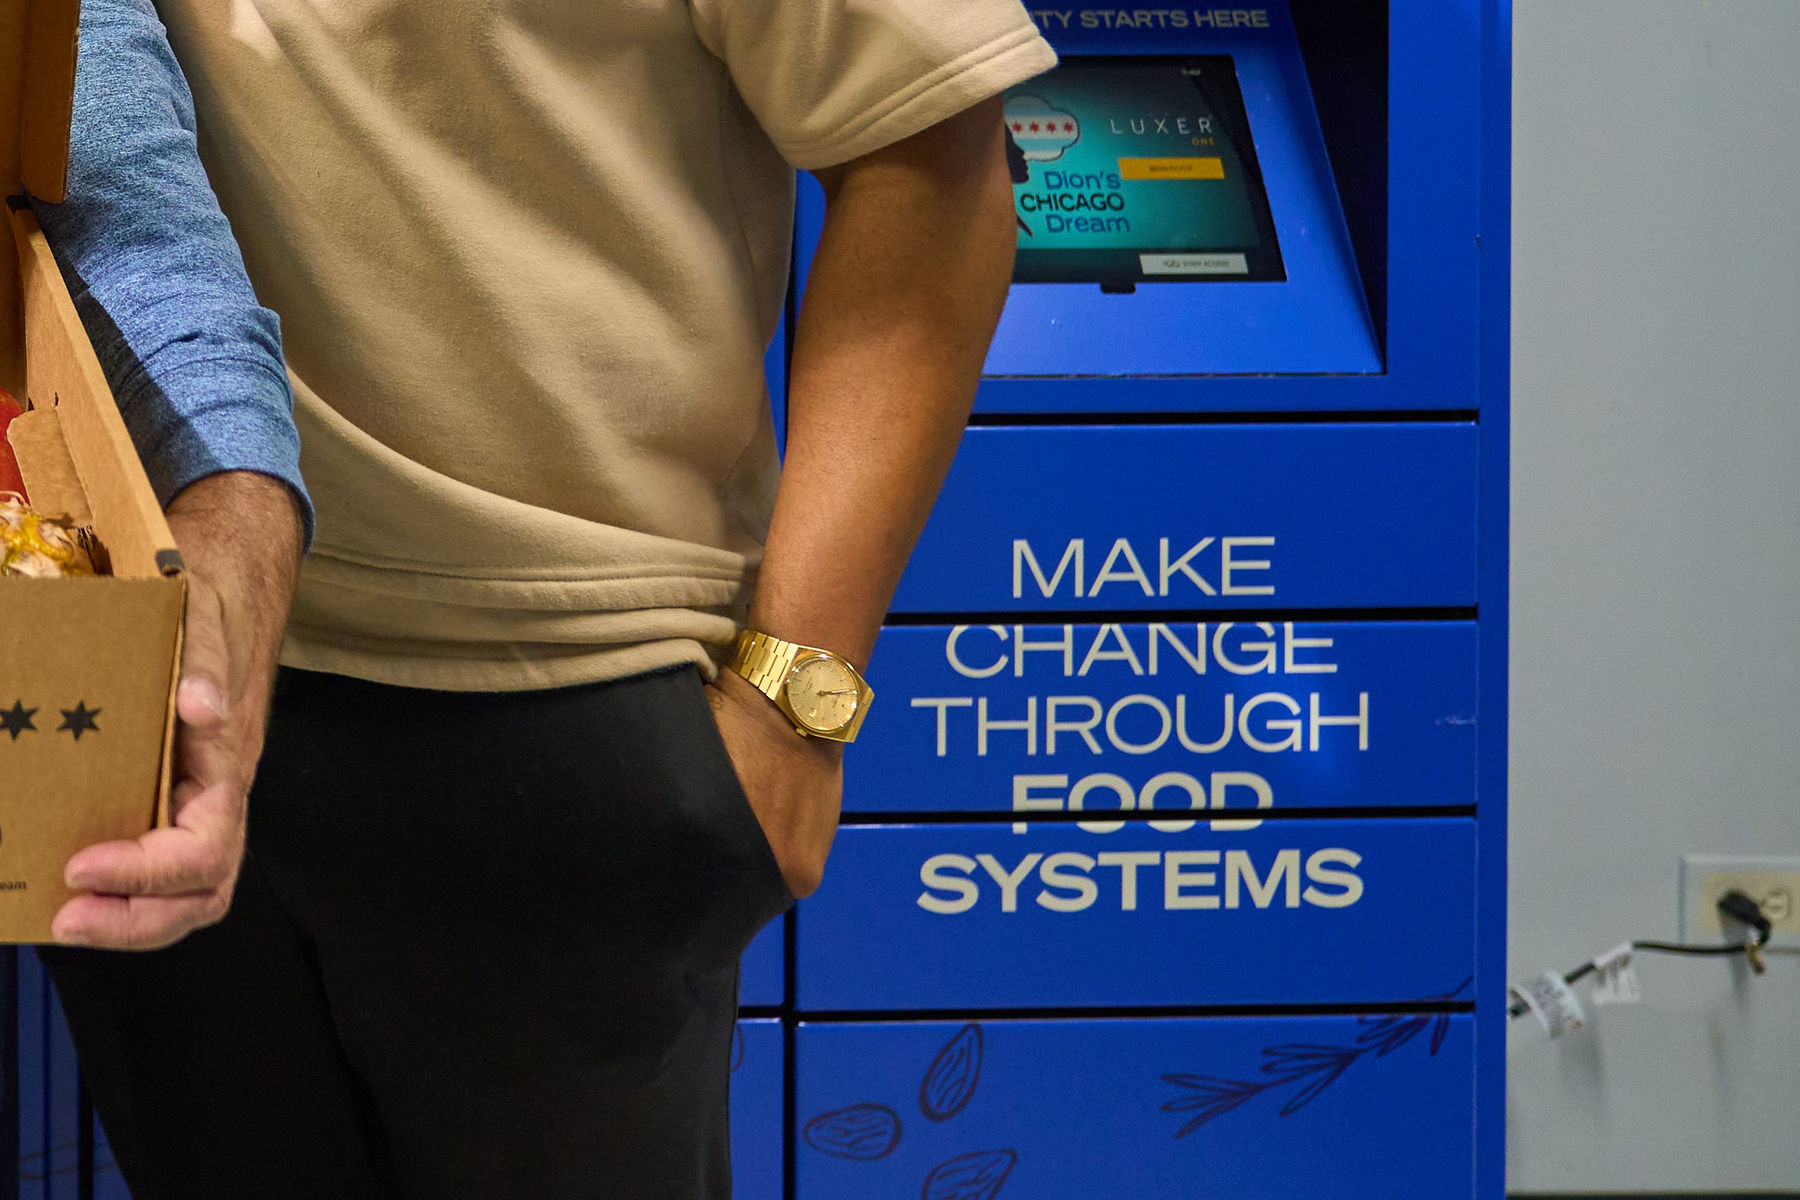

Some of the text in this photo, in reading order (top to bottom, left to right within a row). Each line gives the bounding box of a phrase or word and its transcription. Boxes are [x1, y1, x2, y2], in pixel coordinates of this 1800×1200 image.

[1079, 9, 1189, 29] STARTS
[1193, 8, 1270, 29] HERE
[1109, 116, 1213, 135] LUXER
[1191, 136, 1215, 147] ONE
[1044, 170, 1121, 190] Dion's
[1020, 192, 1125, 212] CHICAGO
[1046, 213, 1131, 234] Dream
[1012, 536, 1275, 599] MAKE
[945, 622, 1338, 678] CHANGE
[910, 691, 1369, 757] THROUGH
[1011, 771, 1274, 835] FOOD
[916, 847, 1364, 914] SYSTEMS
